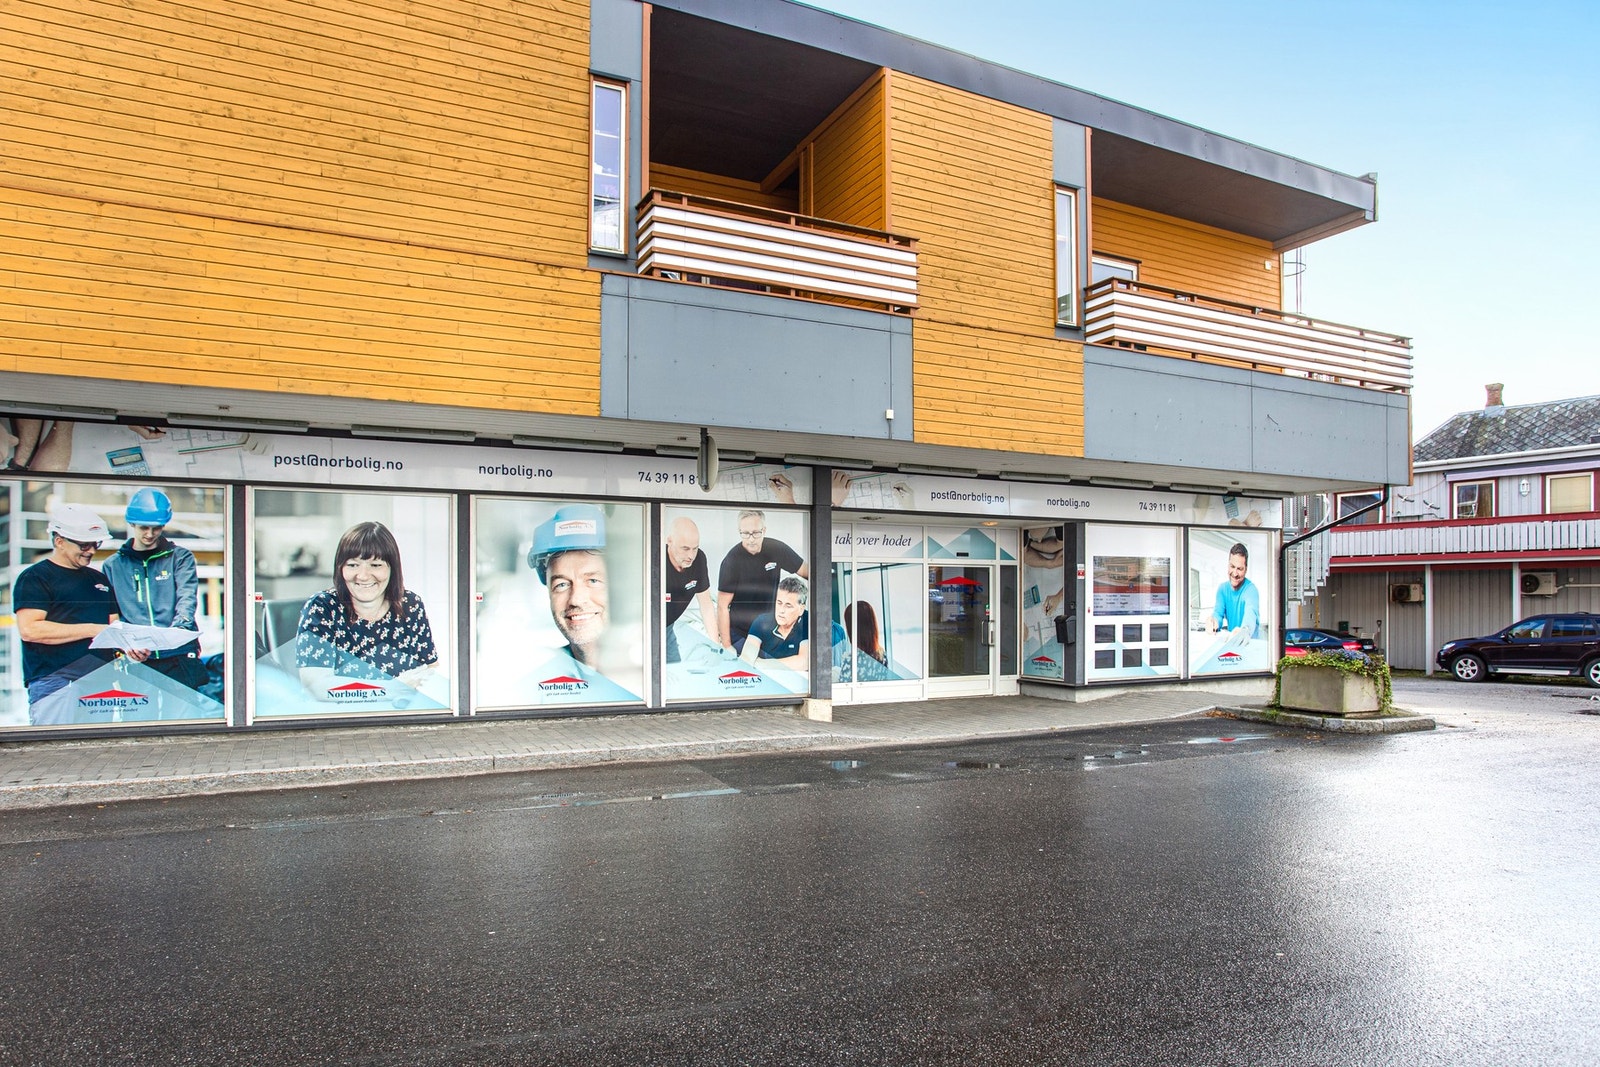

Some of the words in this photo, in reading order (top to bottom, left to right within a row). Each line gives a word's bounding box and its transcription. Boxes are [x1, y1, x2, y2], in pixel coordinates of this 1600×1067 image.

[274, 454, 403, 472] post@norbolig.no
[478, 464, 553, 479] norbolig.no
[638, 471, 652, 483] 74
[655, 472, 669, 484] 39
[673, 473, 685, 485] 11
[688, 474, 699, 485] 8
[930, 490, 1005, 504] post@norbolig.no
[1046, 497, 1091, 509] norbolig.no
[1139, 501, 1148, 511] 74
[1149, 502, 1158, 511] 39
[1159, 503, 1167, 512] 11
[1168, 503, 1176, 512] 81
[834, 533, 852, 545] tak
[882, 534, 912, 546] hodet
[537, 682, 573, 691] Norbolig
[718, 677, 749, 685] Norbolig
[327, 689, 368, 698] Norbolig
[370, 688, 387, 697] A.S
[78, 698, 127, 708] Norbolig
[129, 696, 149, 706] A.S
